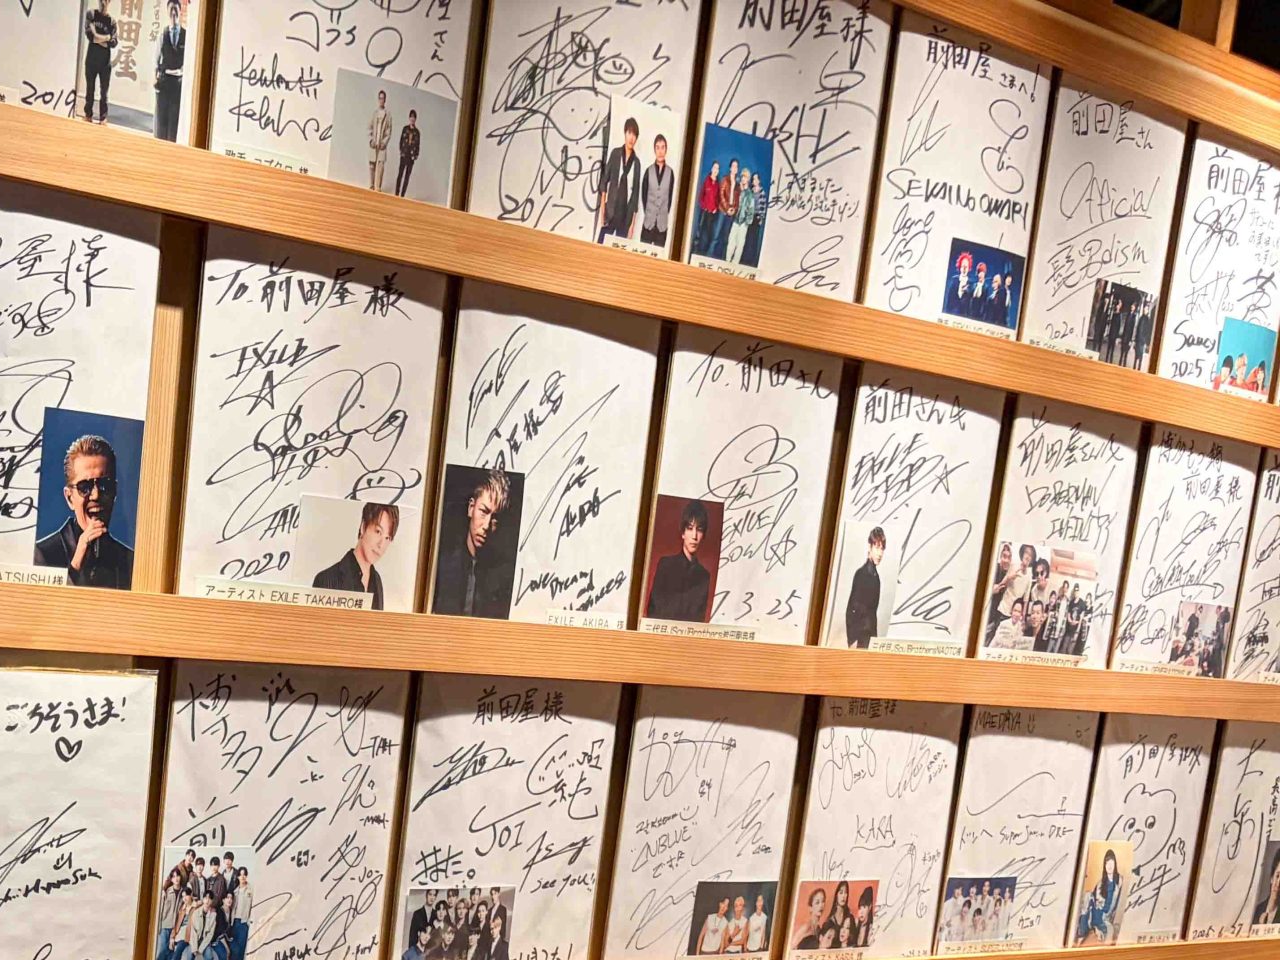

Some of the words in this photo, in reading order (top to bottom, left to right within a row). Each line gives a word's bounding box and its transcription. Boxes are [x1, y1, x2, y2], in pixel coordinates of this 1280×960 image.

[205, 584, 266, 601] アーティスト
[270, 591, 300, 604] EXILE
